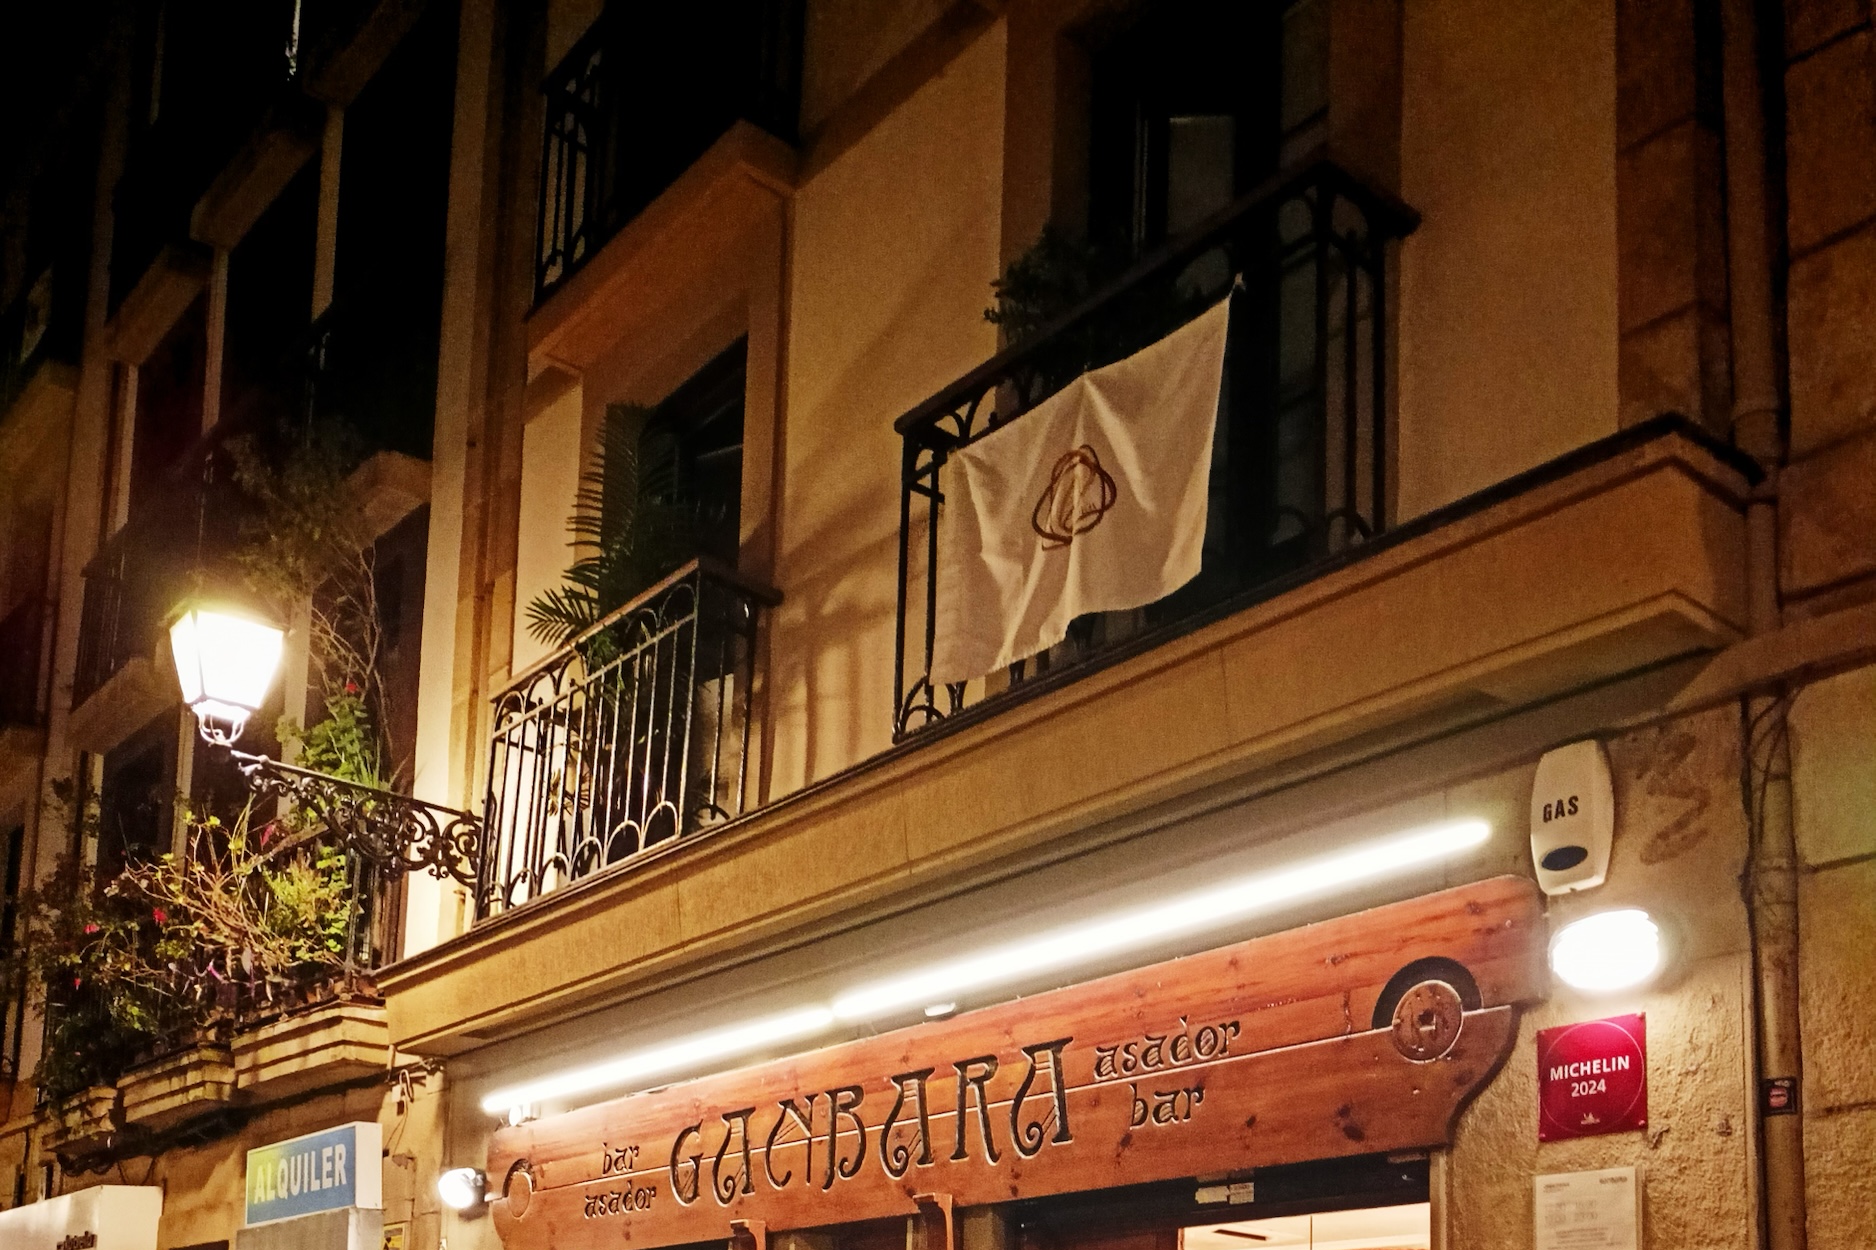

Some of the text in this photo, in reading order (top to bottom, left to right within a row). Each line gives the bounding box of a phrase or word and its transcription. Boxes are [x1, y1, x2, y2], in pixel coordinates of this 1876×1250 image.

[1542, 795, 1579, 823] GAS
[1093, 1014, 1241, 1082] asador
[1549, 1055, 1630, 1081] MICHELIN
[1129, 1082, 1206, 1131] bar
[1570, 1078, 1607, 1098] 2024
[669, 1036, 1074, 1208] GANBARA
[253, 1143, 347, 1205] ALQUILER
[601, 1142, 640, 1176] bar
[583, 1179, 657, 1220] asador
